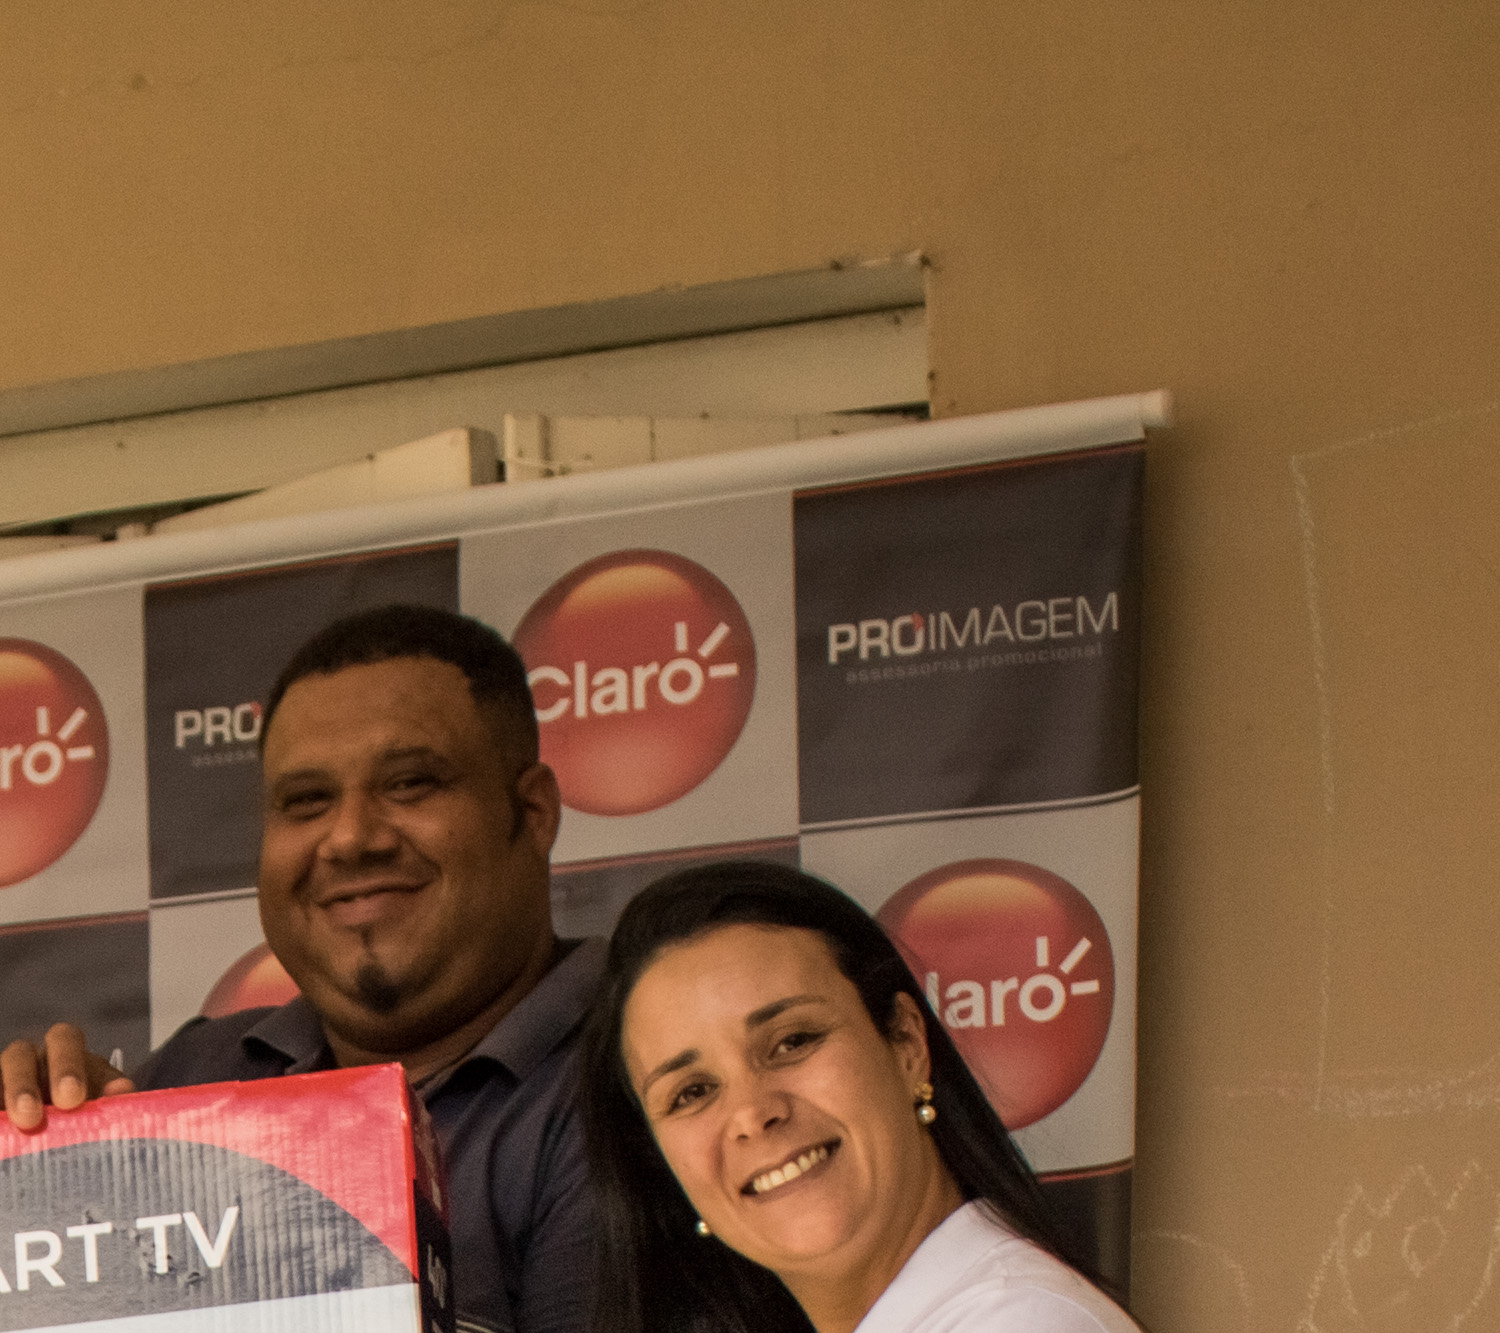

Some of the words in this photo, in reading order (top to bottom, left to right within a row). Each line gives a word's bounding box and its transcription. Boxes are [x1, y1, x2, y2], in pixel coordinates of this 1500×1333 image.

[828, 592, 1119, 665] PROIMAGEM
[525, 657, 703, 723] Claro
[925, 971, 1067, 1031] laro
[136, 1205, 240, 1276] TV
